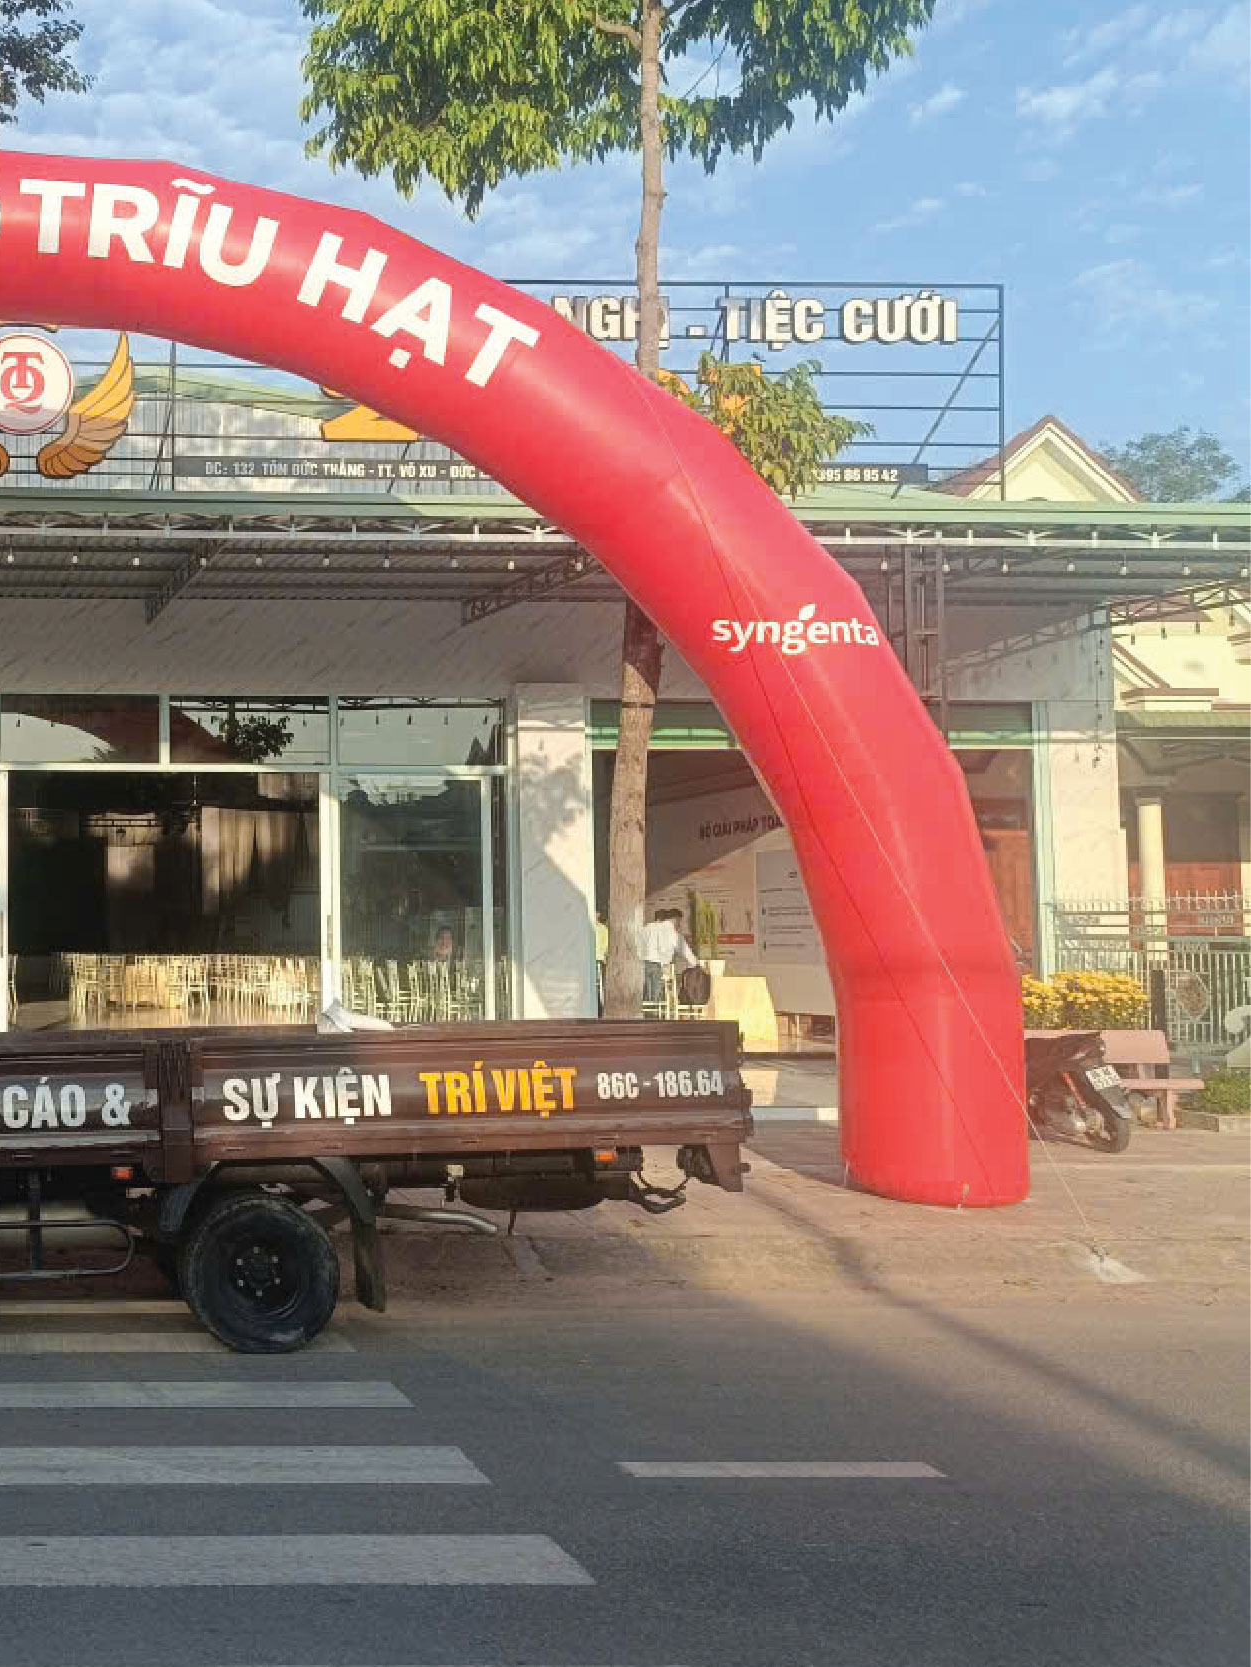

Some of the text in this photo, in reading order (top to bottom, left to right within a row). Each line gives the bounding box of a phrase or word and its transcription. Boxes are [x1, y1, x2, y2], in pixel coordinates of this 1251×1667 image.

[19, 177, 279, 287] TRĨU
[297, 231, 541, 388] HẠT
[716, 289, 825, 351] TIỆC
[841, 289, 958, 345] CƯỚI
[712, 616, 880, 656] syngenta
[2, 1076, 86, 1130] CÁO
[102, 1083, 131, 1126] &
[222, 1072, 281, 1129] SỰ
[294, 1066, 392, 1126] KIỆN
[418, 1059, 487, 1115] TRÍ
[490, 1059, 578, 1119] VIỆT
[597, 1070, 640, 1101] 86C
[652, 1068, 725, 1098] 186.64
